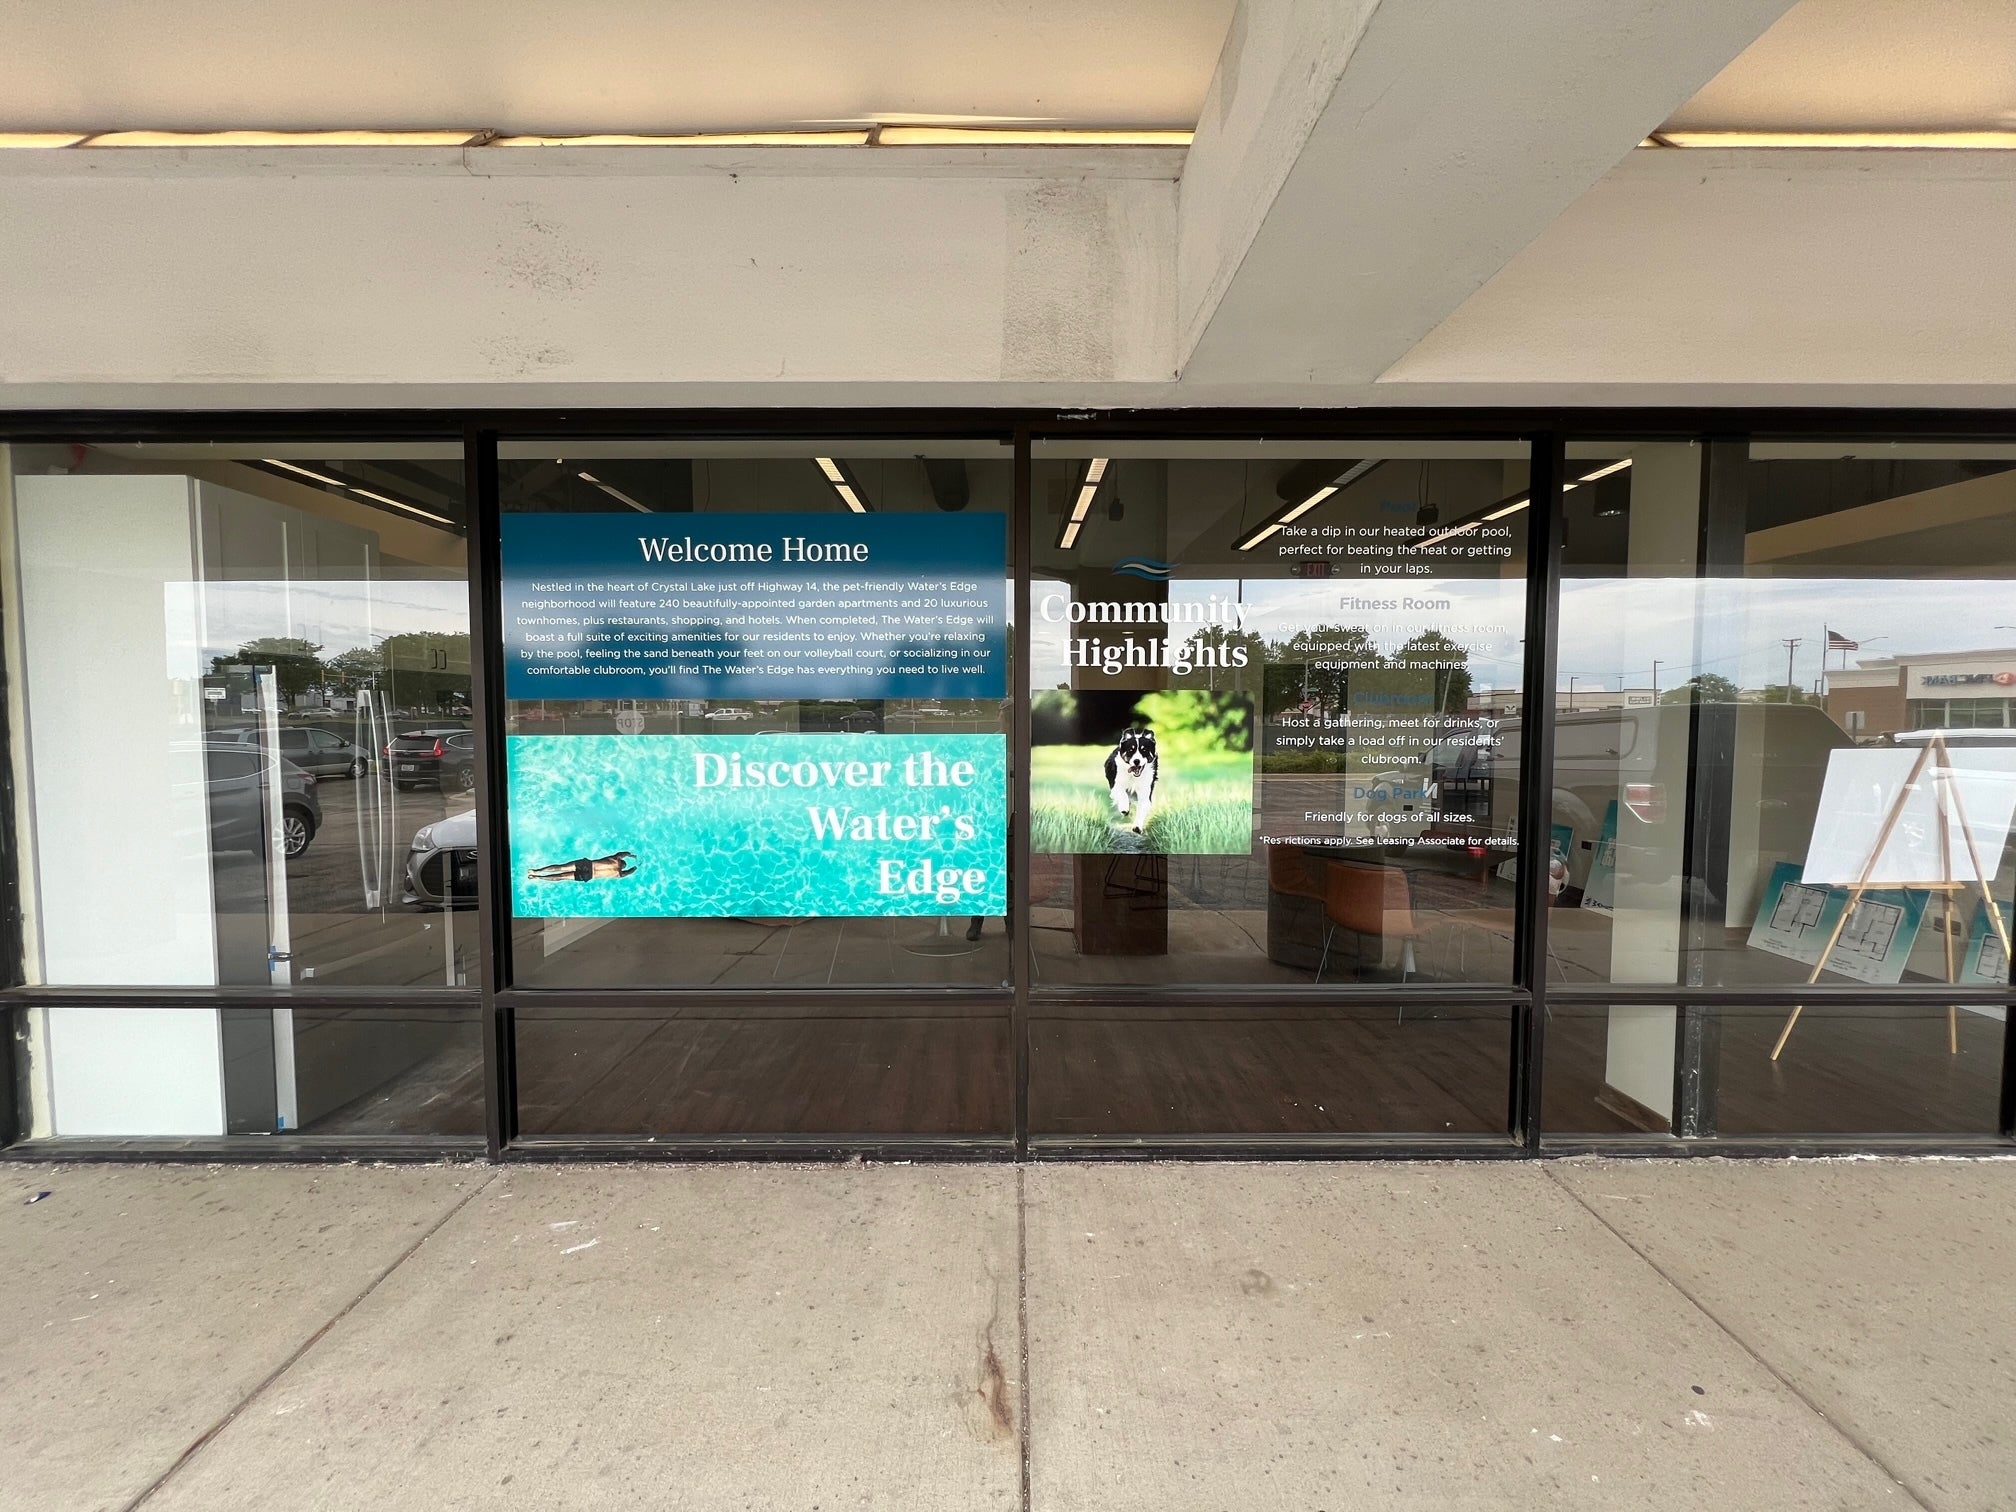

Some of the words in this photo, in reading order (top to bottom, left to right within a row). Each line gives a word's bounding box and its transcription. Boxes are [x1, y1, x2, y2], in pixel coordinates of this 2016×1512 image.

[1281, 526, 1307, 536] Take
[1310, 528, 1318, 536] a
[1322, 525, 1341, 538] dip
[1345, 526, 1355, 536] in
[1360, 528, 1380, 536] our
[1384, 525, 1425, 536] heated
[1429, 525, 1478, 536] outdoor
[1482, 525, 1512, 539] pool,
[638, 536, 772, 562] Welcome
[782, 537, 868, 562] Home
[1279, 544, 1323, 558] perfect
[1327, 544, 1344, 555] for
[1348, 544, 1393, 557] beating
[1398, 544, 1417, 555] the
[1421, 544, 1447, 555] heat
[1451, 547, 1464, 555] or
[1468, 545, 1511, 557] getting
[1306, 563, 1325, 576] EXIT
[1360, 563, 1371, 573] in
[1375, 565, 1402, 576] your
[1406, 563, 1433, 576] laps.
[532, 582, 572, 592] Nestled
[575, 582, 584, 591] in
[587, 582, 604, 592] the
[607, 582, 635, 592] heart
[637, 582, 649, 592] of
[651, 582, 688, 593] Crystal
[690, 582, 716, 592] Lake
[718, 582, 737, 593] just
[740, 581, 755, 591] off
[757, 581, 803, 593] Highway
[806, 582, 820, 592] 14,
[823, 581, 840, 591] the
[843, 581, 904, 593] pet-friendly
[907, 582, 948, 591] Water's
[950, 581, 977, 593] Edge
[522, 599, 596, 610] neighborhood
[598, 599, 616, 608] will
[619, 598, 656, 608] feature
[659, 599, 680, 608] 240
[683, 598, 795, 610] beautifully-appointed
[798, 598, 835, 610] garden
[838, 599, 898, 609] apartments
[901, 598, 921, 608] and
[923, 598, 938, 608] 20
[941, 598, 988, 608] luxurious
[1340, 598, 1397, 610] Fitness
[1403, 598, 1450, 610] Room
[1040, 594, 1252, 631] Community
[517, 616, 580, 626] townhomes,
[583, 616, 605, 626] plus
[607, 616, 669, 626] restaurants,
[671, 615, 723, 627] shopping,
[725, 615, 746, 625] and
[748, 615, 782, 625] hotels.
[785, 615, 817, 625] When
[819, 615, 878, 626] completed,
[881, 615, 901, 624] The
[903, 615, 943, 624] Water's
[946, 615, 975, 626] Edge
[976, 615, 994, 624] will
[526, 633, 555, 641] boast
[567, 632, 583, 641] full
[586, 632, 611, 642] suite
[613, 632, 625, 642] of
[627, 632, 669, 643] exciting
[671, 632, 722, 642] amenities
[724, 632, 739, 641] for
[763, 632, 811, 641] residents
[813, 633, 825, 641] to
[827, 632, 857, 642] enjoy.
[860, 632, 906, 641] Whether
[909, 632, 941, 642] you're
[944, 632, 985, 643] relaxing
[521, 649, 533, 660] by
[537, 649, 554, 658] the
[557, 649, 583, 659] pool,
[585, 648, 621, 660] feeling
[623, 648, 641, 658] the
[643, 648, 670, 658] sand
[671, 648, 714, 658] beneath
[717, 650, 741, 660] your
[743, 648, 764, 657] feet
[804, 648, 853, 659] volleyball
[856, 649, 886, 658] court,
[889, 650, 901, 658] or
[903, 648, 958, 659] socializing
[961, 648, 970, 657] in
[1060, 636, 1249, 676] Highlights
[527, 665, 591, 675] comfortable
[593, 665, 646, 675] clubroom,
[648, 665, 676, 676] you'll
[679, 665, 699, 674] find
[702, 665, 722, 674] The
[724, 665, 764, 674] Water's
[767, 665, 794, 675] Edge
[797, 665, 815, 674] has
[818, 665, 873, 676] everything
[876, 667, 896, 675] you
[898, 665, 925, 674] need
[927, 665, 939, 674] to
[941, 664, 959, 674] live
[962, 664, 985, 674] well.
[1314, 659, 1380, 672] equipment
[1384, 659, 1406, 670] and
[1410, 659, 1470, 670] machines.
[1352, 692, 1433, 706] Clubroom
[1282, 717, 1309, 728] Host
[1313, 720, 1321, 728] a
[1324, 717, 1385, 730] gathering,
[1389, 718, 1419, 728] meet
[1423, 717, 1440, 728] for
[1444, 717, 1483, 730] drinks,
[1487, 720, 1500, 728] or
[1276, 736, 1315, 749] simply
[1319, 736, 1344, 746] take
[1348, 738, 1355, 746] a
[1359, 736, 1385, 746] load
[1388, 735, 1405, 746] off
[1409, 736, 1419, 746] in
[1423, 738, 1444, 746] our
[1447, 736, 1504, 746] residents'
[1361, 754, 1421, 764] clubroom.
[694, 751, 891, 788] Discover
[904, 751, 974, 788] the
[1354, 787, 1387, 801] Dog
[1393, 787, 1427, 799] Park
[808, 804, 975, 842] Water's
[1304, 812, 1353, 825] Friendly
[1357, 812, 1374, 822] for
[1377, 812, 1407, 825] dogs
[1410, 812, 1424, 822] of
[1427, 812, 1440, 822] all
[1443, 812, 1475, 822] sizes.
[1323, 837, 1353, 848] apply.
[1356, 837, 1374, 846] See
[1377, 836, 1414, 848] Leasing
[1418, 836, 1465, 846] Associate
[1468, 836, 1482, 846] for
[1485, 836, 1519, 846] details.
[878, 859, 986, 904] Edge
